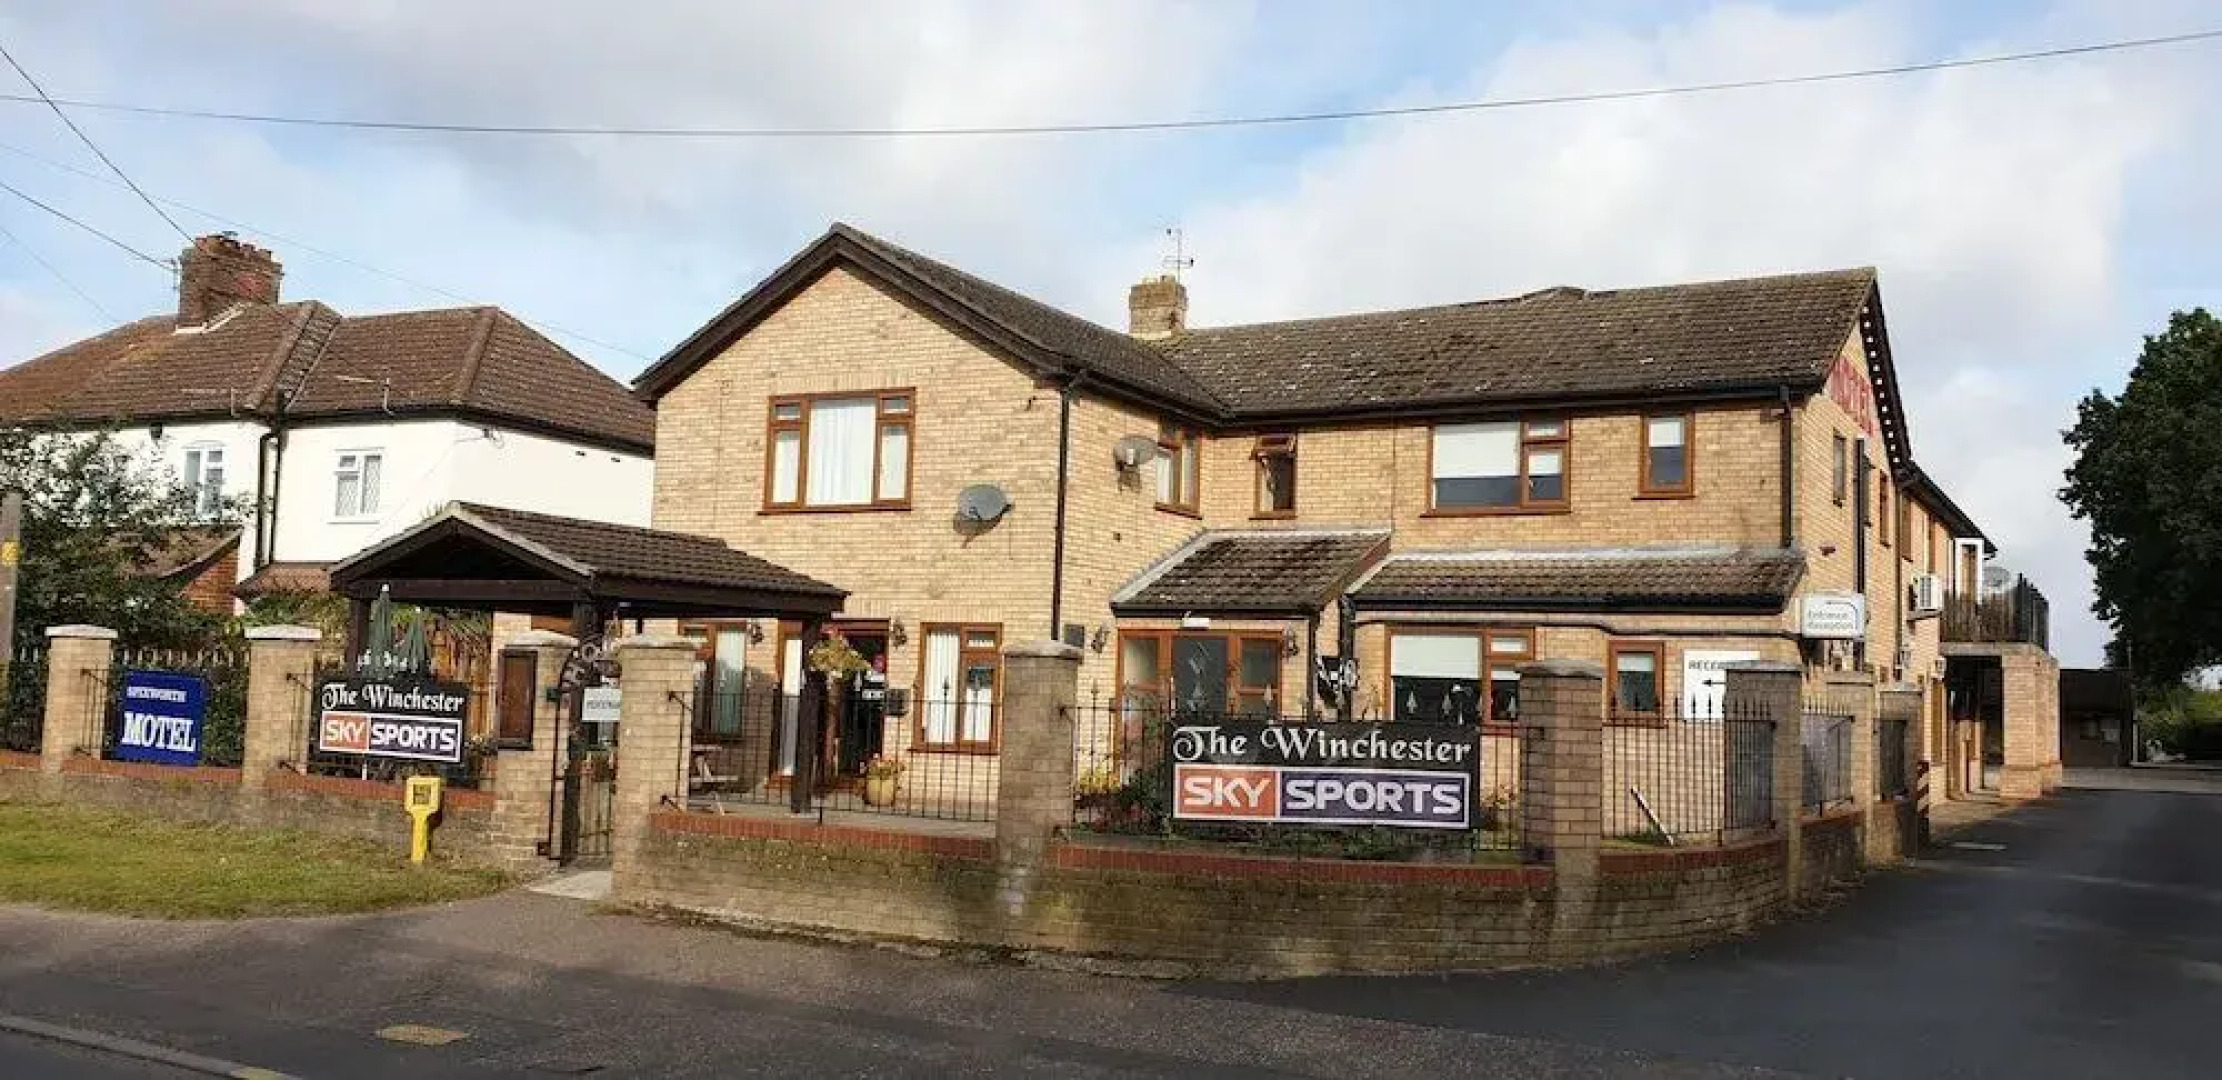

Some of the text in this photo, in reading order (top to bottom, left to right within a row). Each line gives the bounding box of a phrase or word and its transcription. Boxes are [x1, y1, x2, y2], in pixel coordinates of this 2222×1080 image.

[321, 682, 464, 712] The Winchester
[120, 710, 197, 752] MOTEL
[325, 719, 456, 751] SKY SPORTS
[1173, 726, 1472, 763] The Winchester
[1183, 775, 1462, 815] SKY SPORTS
